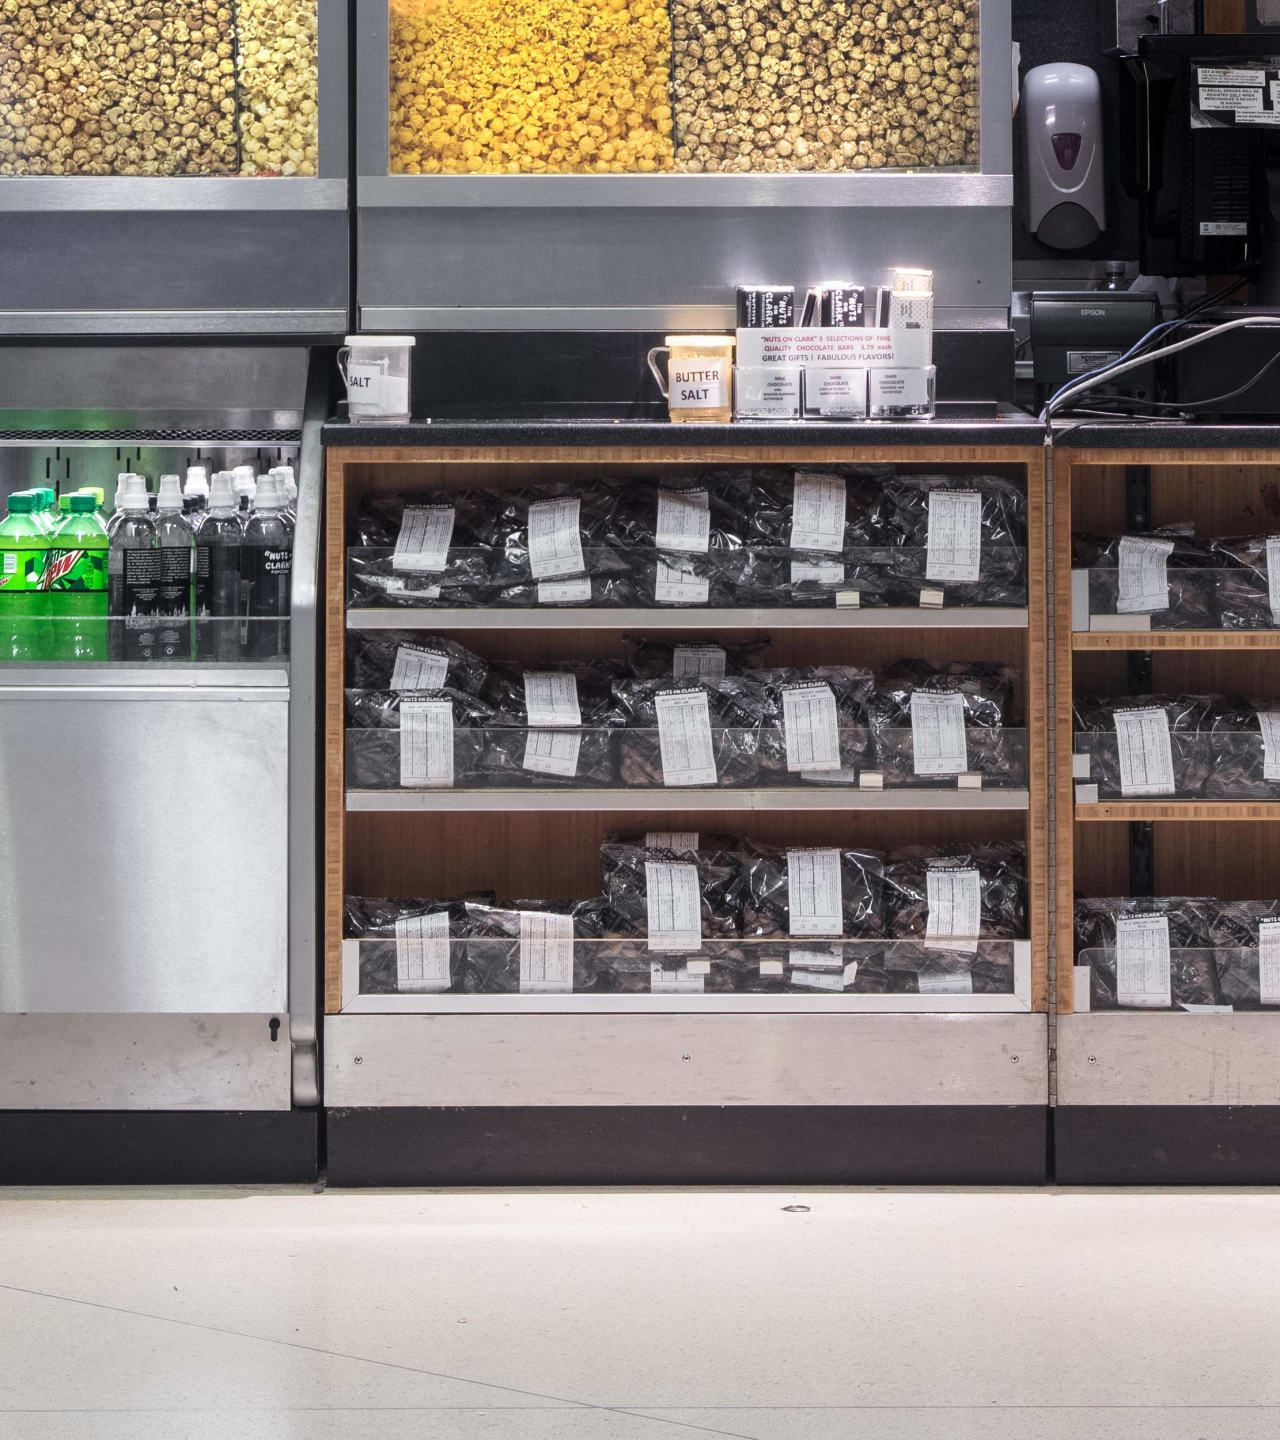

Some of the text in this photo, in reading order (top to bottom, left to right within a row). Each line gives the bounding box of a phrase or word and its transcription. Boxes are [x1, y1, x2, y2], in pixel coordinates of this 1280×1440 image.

[350, 376, 371, 387] SALT
[676, 370, 719, 382] BUTTER
[681, 389, 709, 400] SALT
